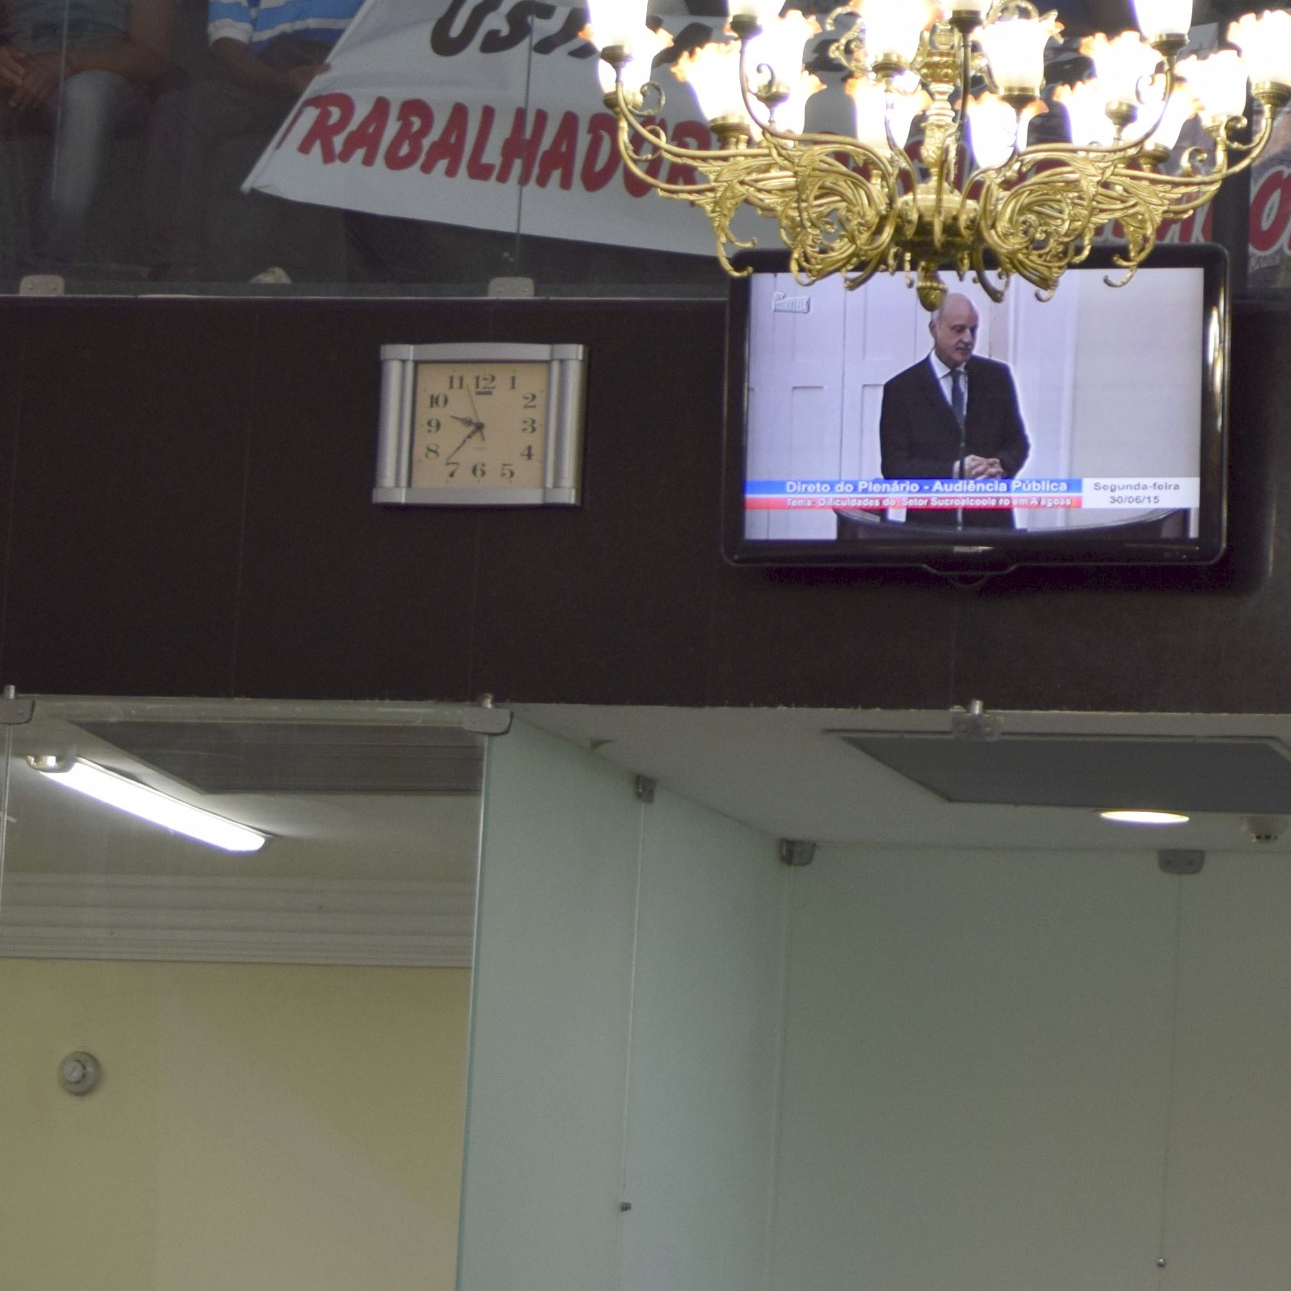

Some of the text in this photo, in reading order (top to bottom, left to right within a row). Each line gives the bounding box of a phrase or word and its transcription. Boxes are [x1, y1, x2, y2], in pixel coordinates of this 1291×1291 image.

[448, 375, 464, 391] 11
[474, 374, 497, 390] 12
[508, 375, 517, 391] 1
[428, 393, 449, 409] 10
[521, 392, 538, 409] 2
[426, 418, 441, 434] 9
[521, 417, 538, 434] 3
[424, 443, 441, 460] 8
[519, 444, 536, 461] 4
[444, 462, 460, 479] 7
[471, 462, 487, 479] 6
[500, 462, 516, 480] 5
[785, 481, 831, 493] Direto
[835, 481, 855, 493] do
[857, 480, 920, 493] Plenário
[932, 478, 1008, 492] Audiência
[1011, 478, 1068, 492] Pública
[1093, 481, 1181, 493] Segunda-feira
[901, 497, 929, 507] Setor
[1109, 494, 1161, 504] 30/06/15
